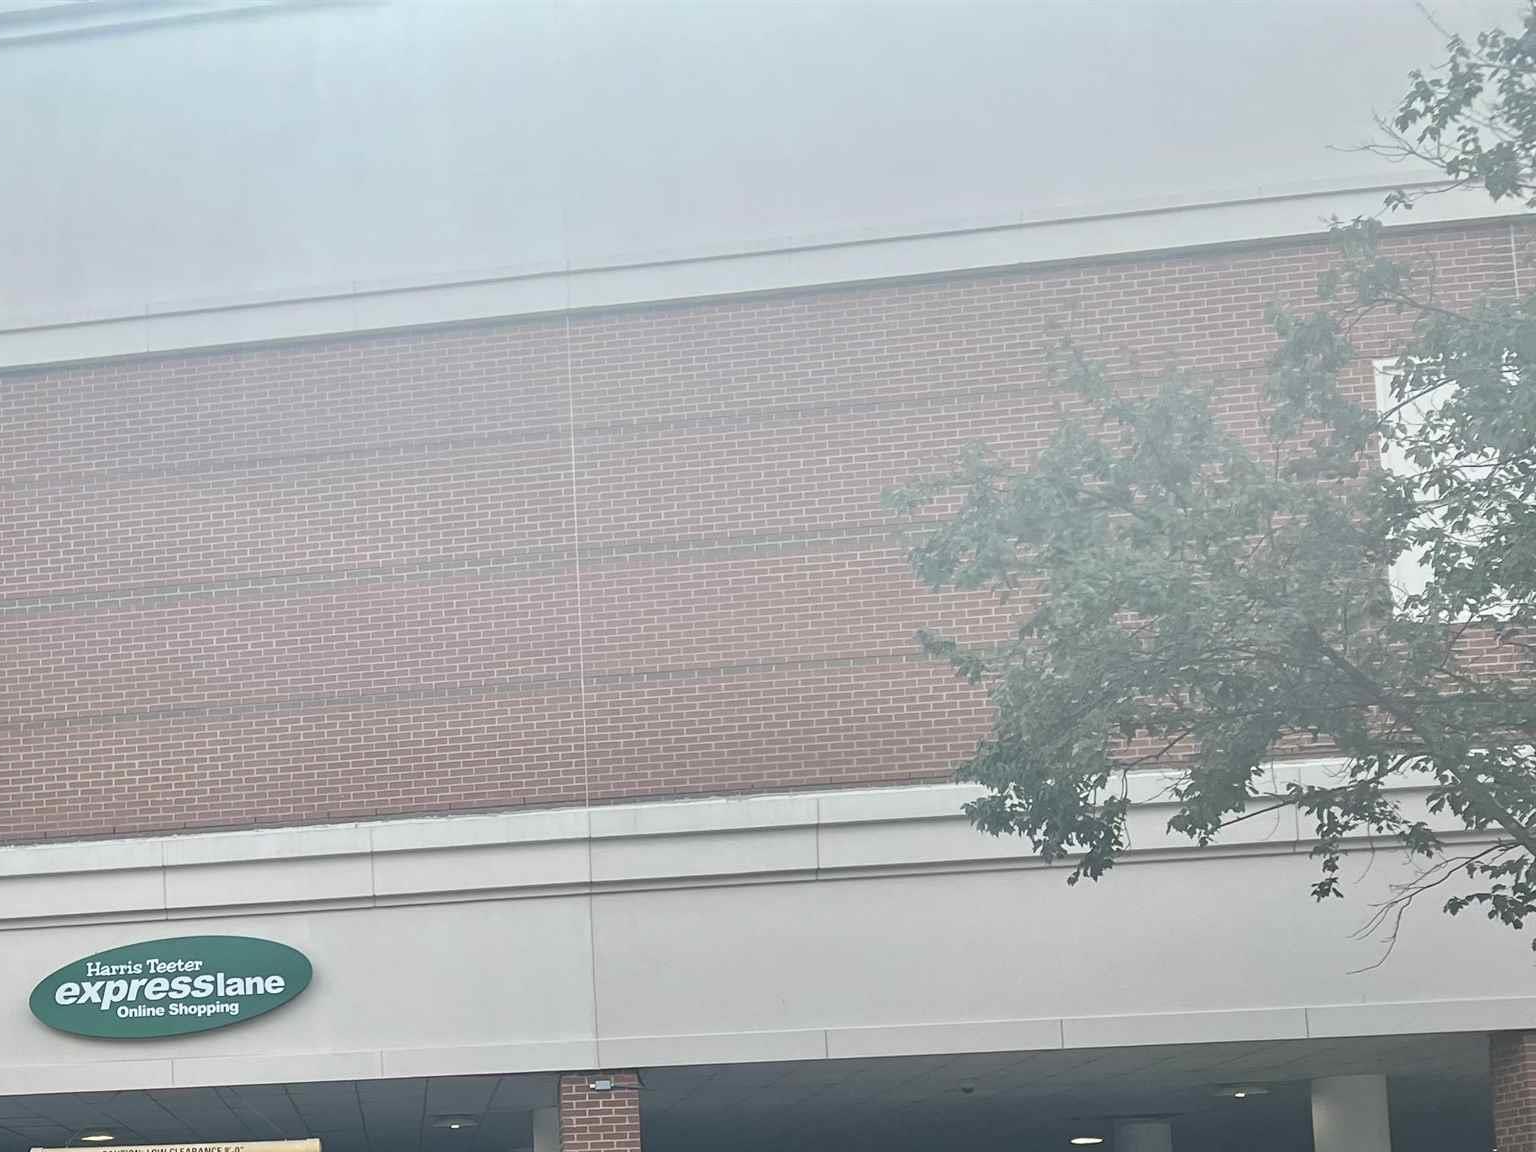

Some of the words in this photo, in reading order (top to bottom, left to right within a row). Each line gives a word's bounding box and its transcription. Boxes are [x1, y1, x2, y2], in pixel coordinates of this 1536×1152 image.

[86, 961, 143, 977] Harris
[146, 958, 203, 974] Teeter
[117, 1003, 165, 1018] Online
[168, 1001, 240, 1016] Shopping
